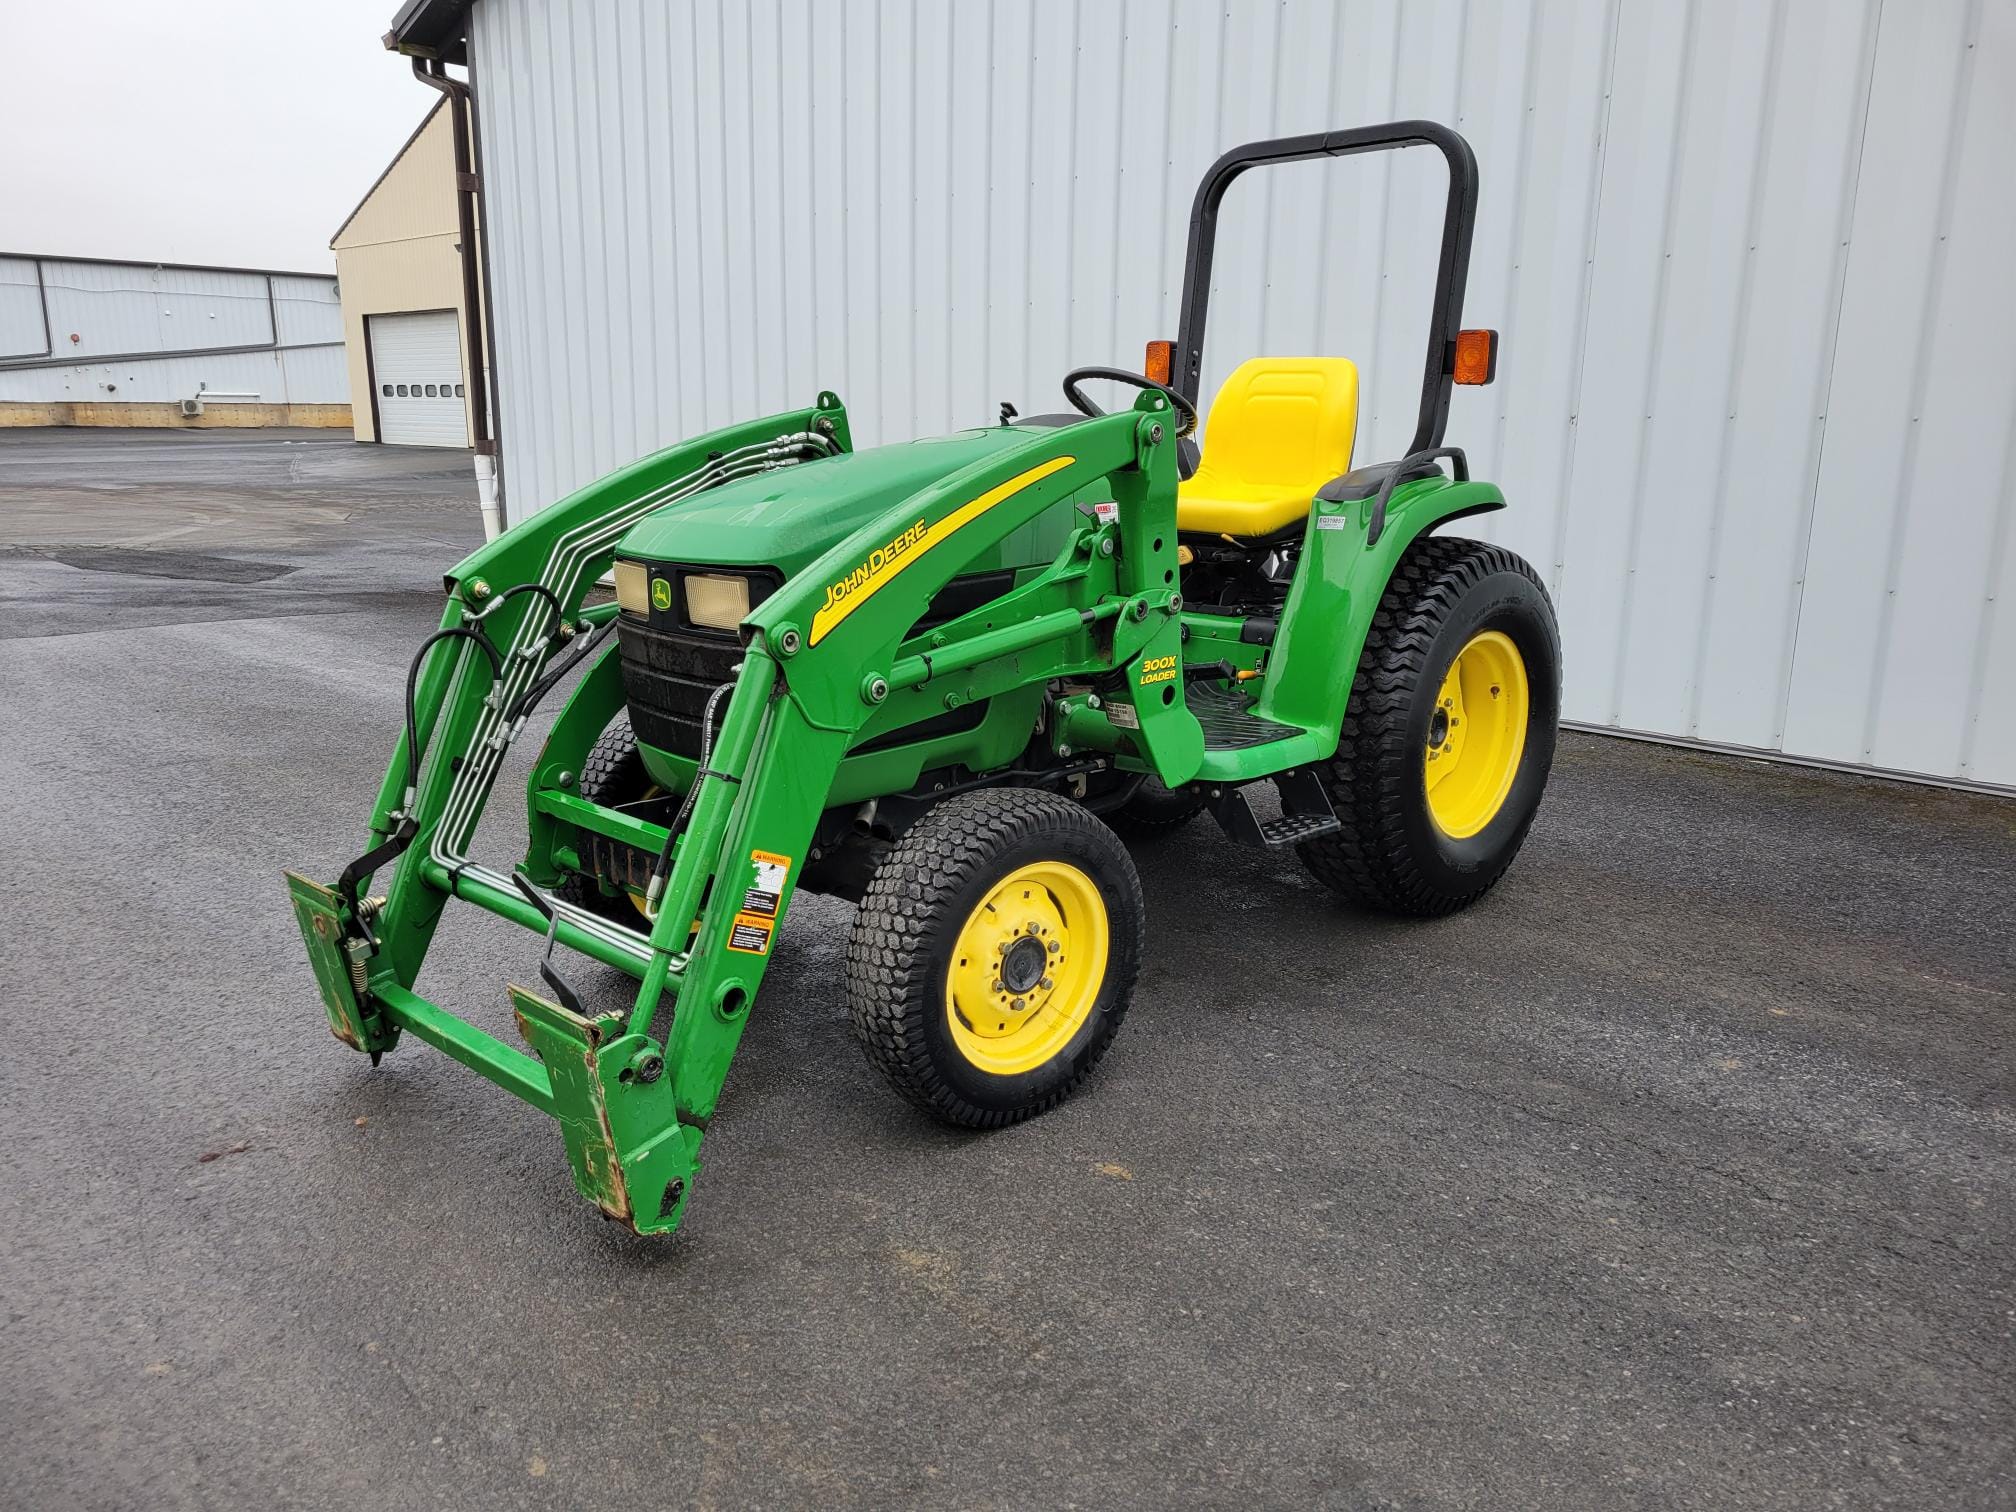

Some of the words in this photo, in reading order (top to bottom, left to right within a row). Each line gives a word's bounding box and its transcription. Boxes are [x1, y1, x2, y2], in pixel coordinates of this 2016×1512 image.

[822, 561, 871, 612] JOHN
[868, 518, 928, 575] DEERE
[1142, 655, 1177, 673] 300X
[1140, 669, 1176, 685] LOADER
[761, 854, 786, 865] WARNING
[745, 919, 770, 927] WARNING
